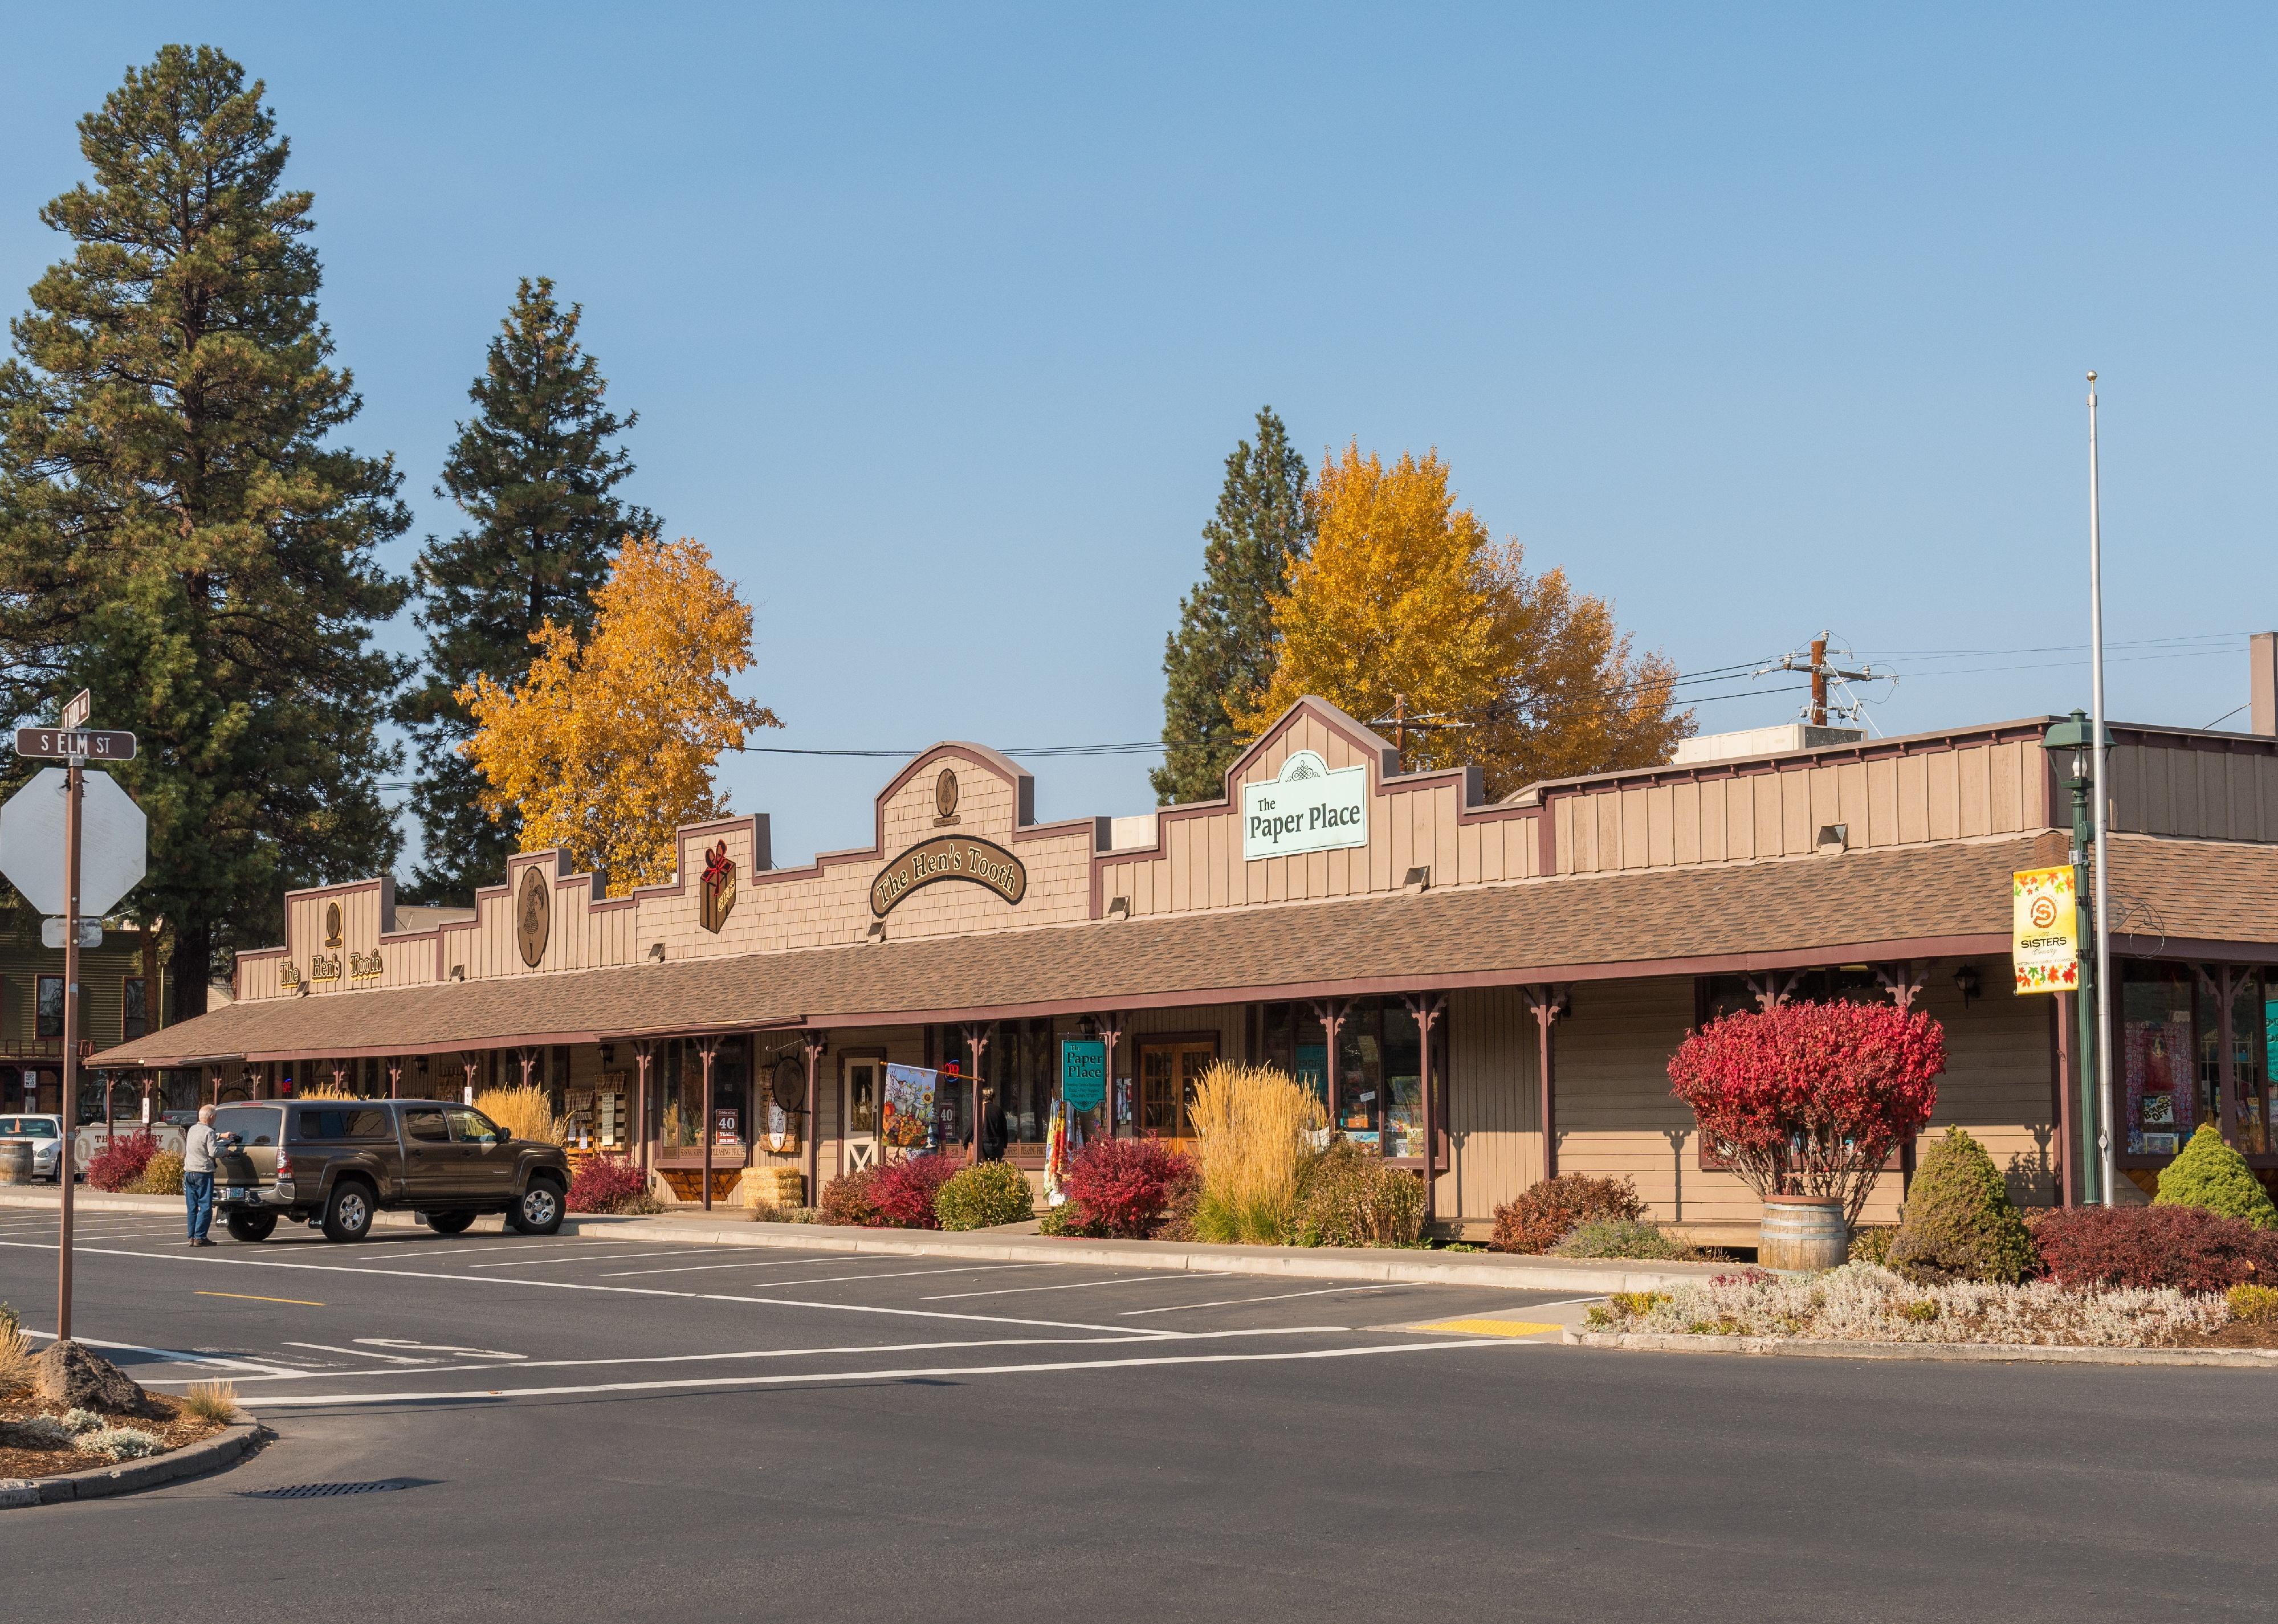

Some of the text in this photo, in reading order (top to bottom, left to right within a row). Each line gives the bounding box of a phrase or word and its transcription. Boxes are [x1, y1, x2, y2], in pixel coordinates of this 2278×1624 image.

[68, 701, 79, 728] HOOD
[41, 733, 111, 754] S ELM ST
[1257, 798, 1276, 811] The
[1250, 802, 1360, 843] Paper Place
[877, 843, 1015, 907] The Hen's Tooth
[2021, 937, 2067, 949] SISTERS
[280, 949, 382, 985] The Hen's Tooth
[1066, 1052, 1102, 1067] Paper
[1067, 1066, 1101, 1078] Place
[940, 1108, 953, 1122] 40
[2143, 1099, 2171, 1120] BOUNCE
[2152, 1108, 2169, 1121] OFF
[719, 1117, 735, 1129] 40
[731, 1148, 745, 1156] PRICES
